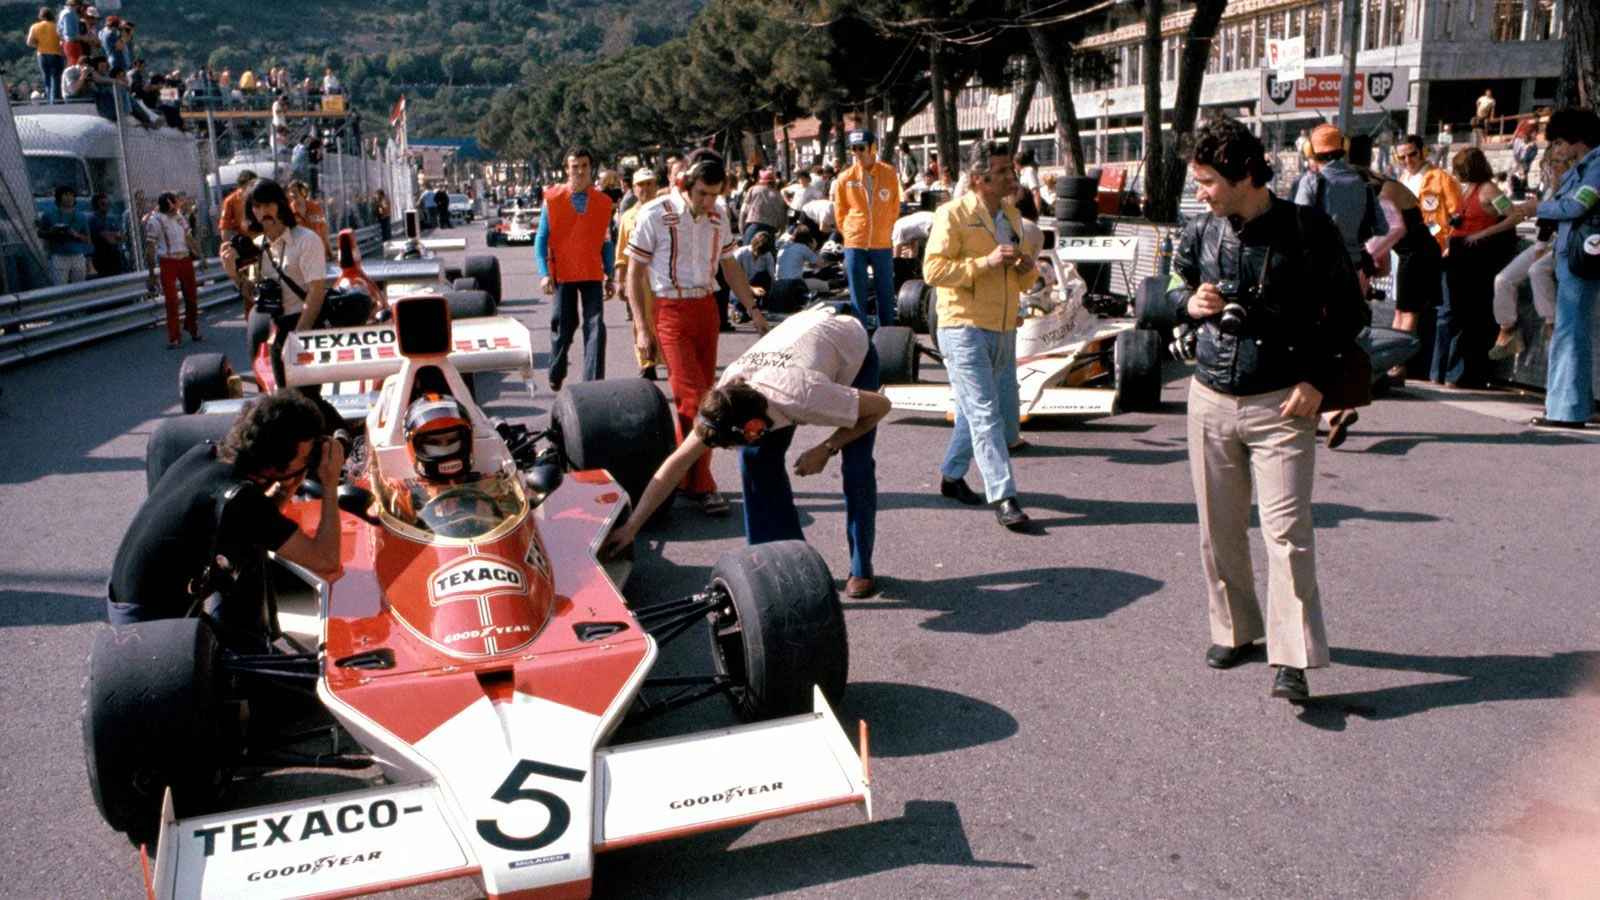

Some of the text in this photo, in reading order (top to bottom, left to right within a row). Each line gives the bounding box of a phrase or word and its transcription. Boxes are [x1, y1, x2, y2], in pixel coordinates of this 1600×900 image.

[1271, 80, 1290, 98] BP
[1298, 77, 1363, 91] BP coue
[1372, 76, 1392, 97] BP
[1058, 238, 1132, 248] RDLEY
[298, 330, 395, 350] TEXACO
[436, 567, 520, 591] TEXACO
[476, 759, 587, 852] 5
